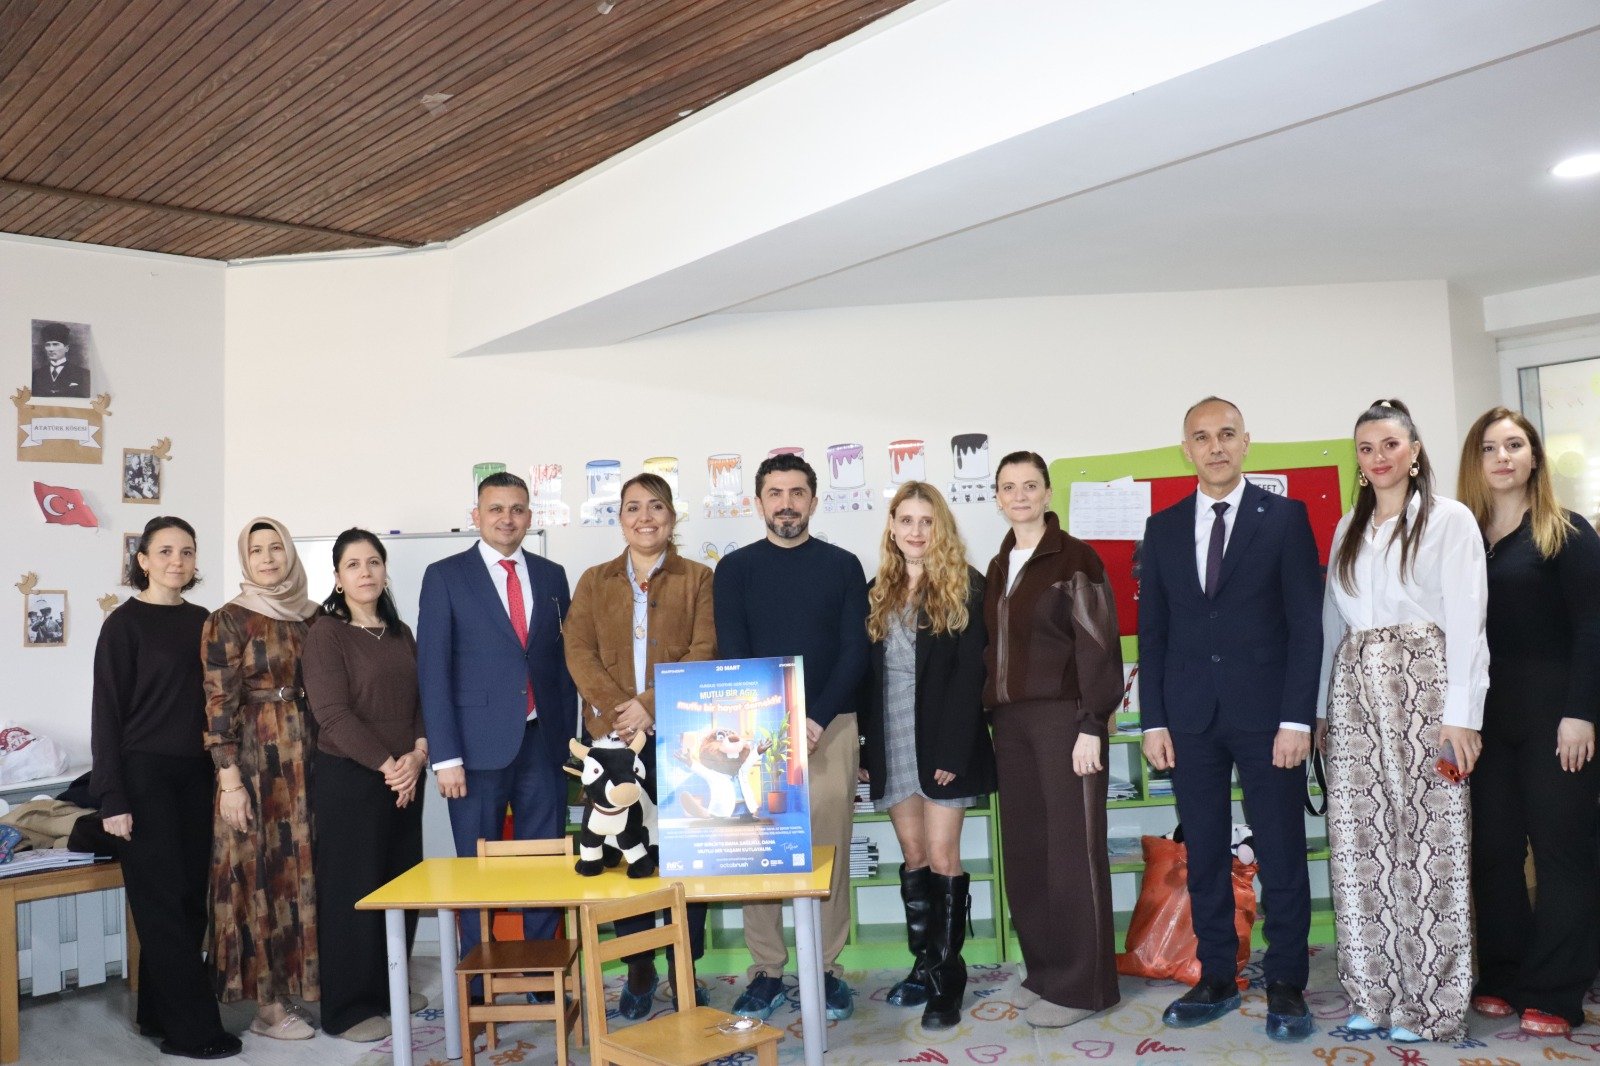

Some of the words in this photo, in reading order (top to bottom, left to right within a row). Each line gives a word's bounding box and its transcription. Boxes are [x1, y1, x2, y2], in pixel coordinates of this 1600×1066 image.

[34, 424, 64, 432] ATATÜRK
[724, 664, 741, 672] MART
[699, 689, 724, 700] MUTLU
[677, 700, 702, 711] mutlu
